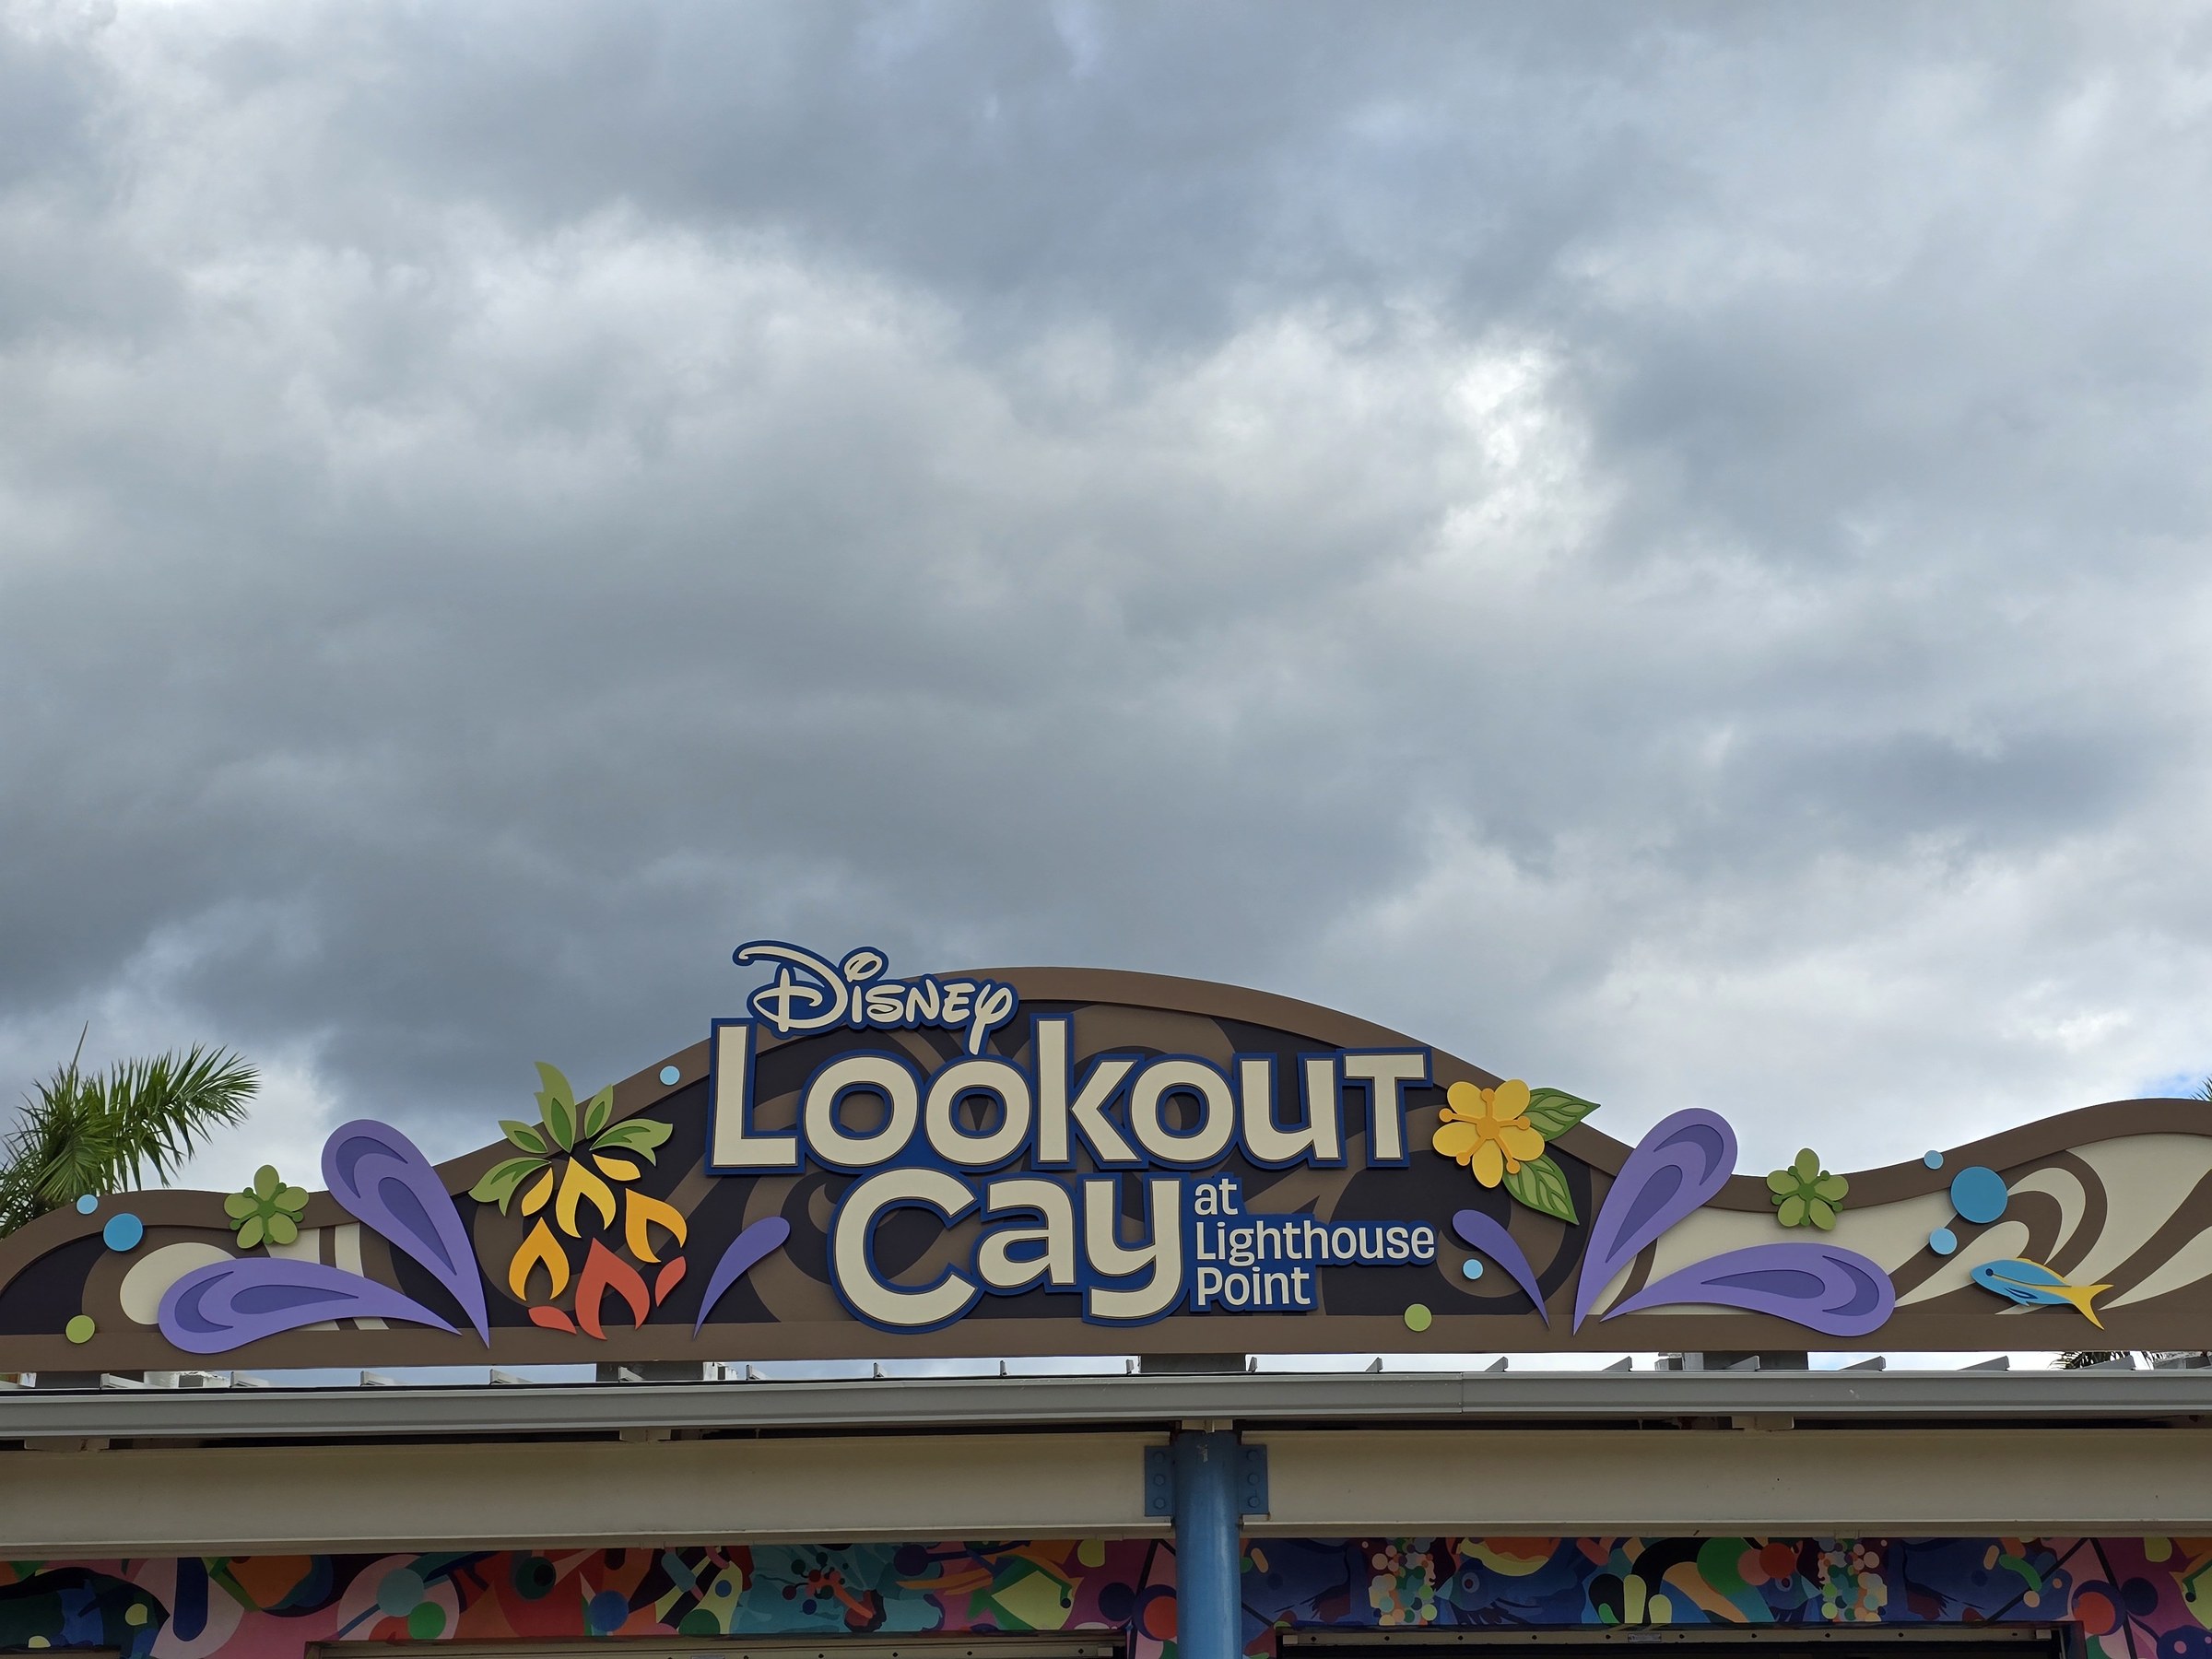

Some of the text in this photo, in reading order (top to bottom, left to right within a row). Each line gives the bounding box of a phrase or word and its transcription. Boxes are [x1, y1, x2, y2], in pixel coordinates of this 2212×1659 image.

[712, 1019, 1426, 1168] Lookout
[1194, 1177, 1239, 1216] at
[833, 1167, 1182, 1324] Cay
[1195, 1219, 1435, 1266] Lighthouse
[1196, 1266, 1312, 1306] Point
